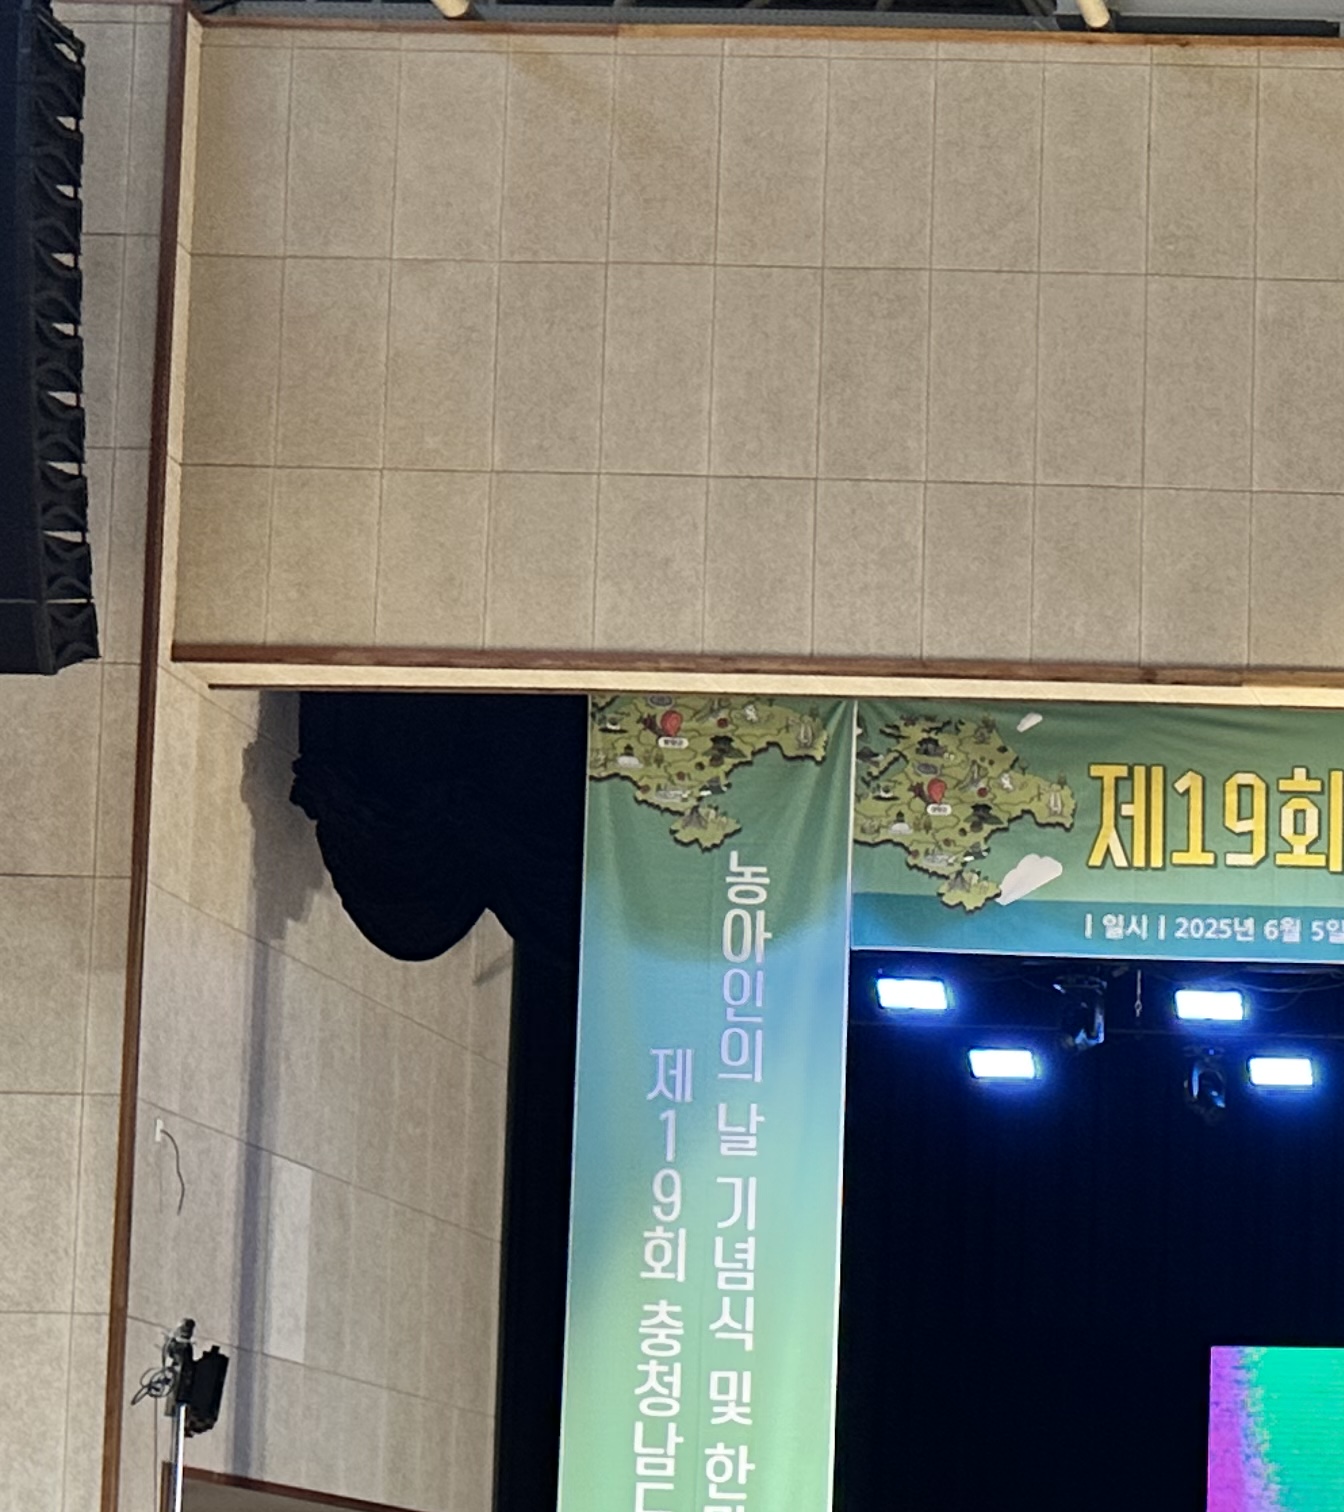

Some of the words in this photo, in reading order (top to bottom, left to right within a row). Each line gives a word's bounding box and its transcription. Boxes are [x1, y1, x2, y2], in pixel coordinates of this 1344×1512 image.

[716, 850, 773, 1083] 농아인의
[1102, 914, 1149, 940] 일시
[1174, 916, 1255, 942] 2025년
[1264, 918, 1300, 944] 6월
[640, 1047, 694, 1283] 제19회
[716, 1103, 766, 1157] 날
[708, 1176, 758, 1352] 기념식
[709, 1370, 753, 1426] 및
